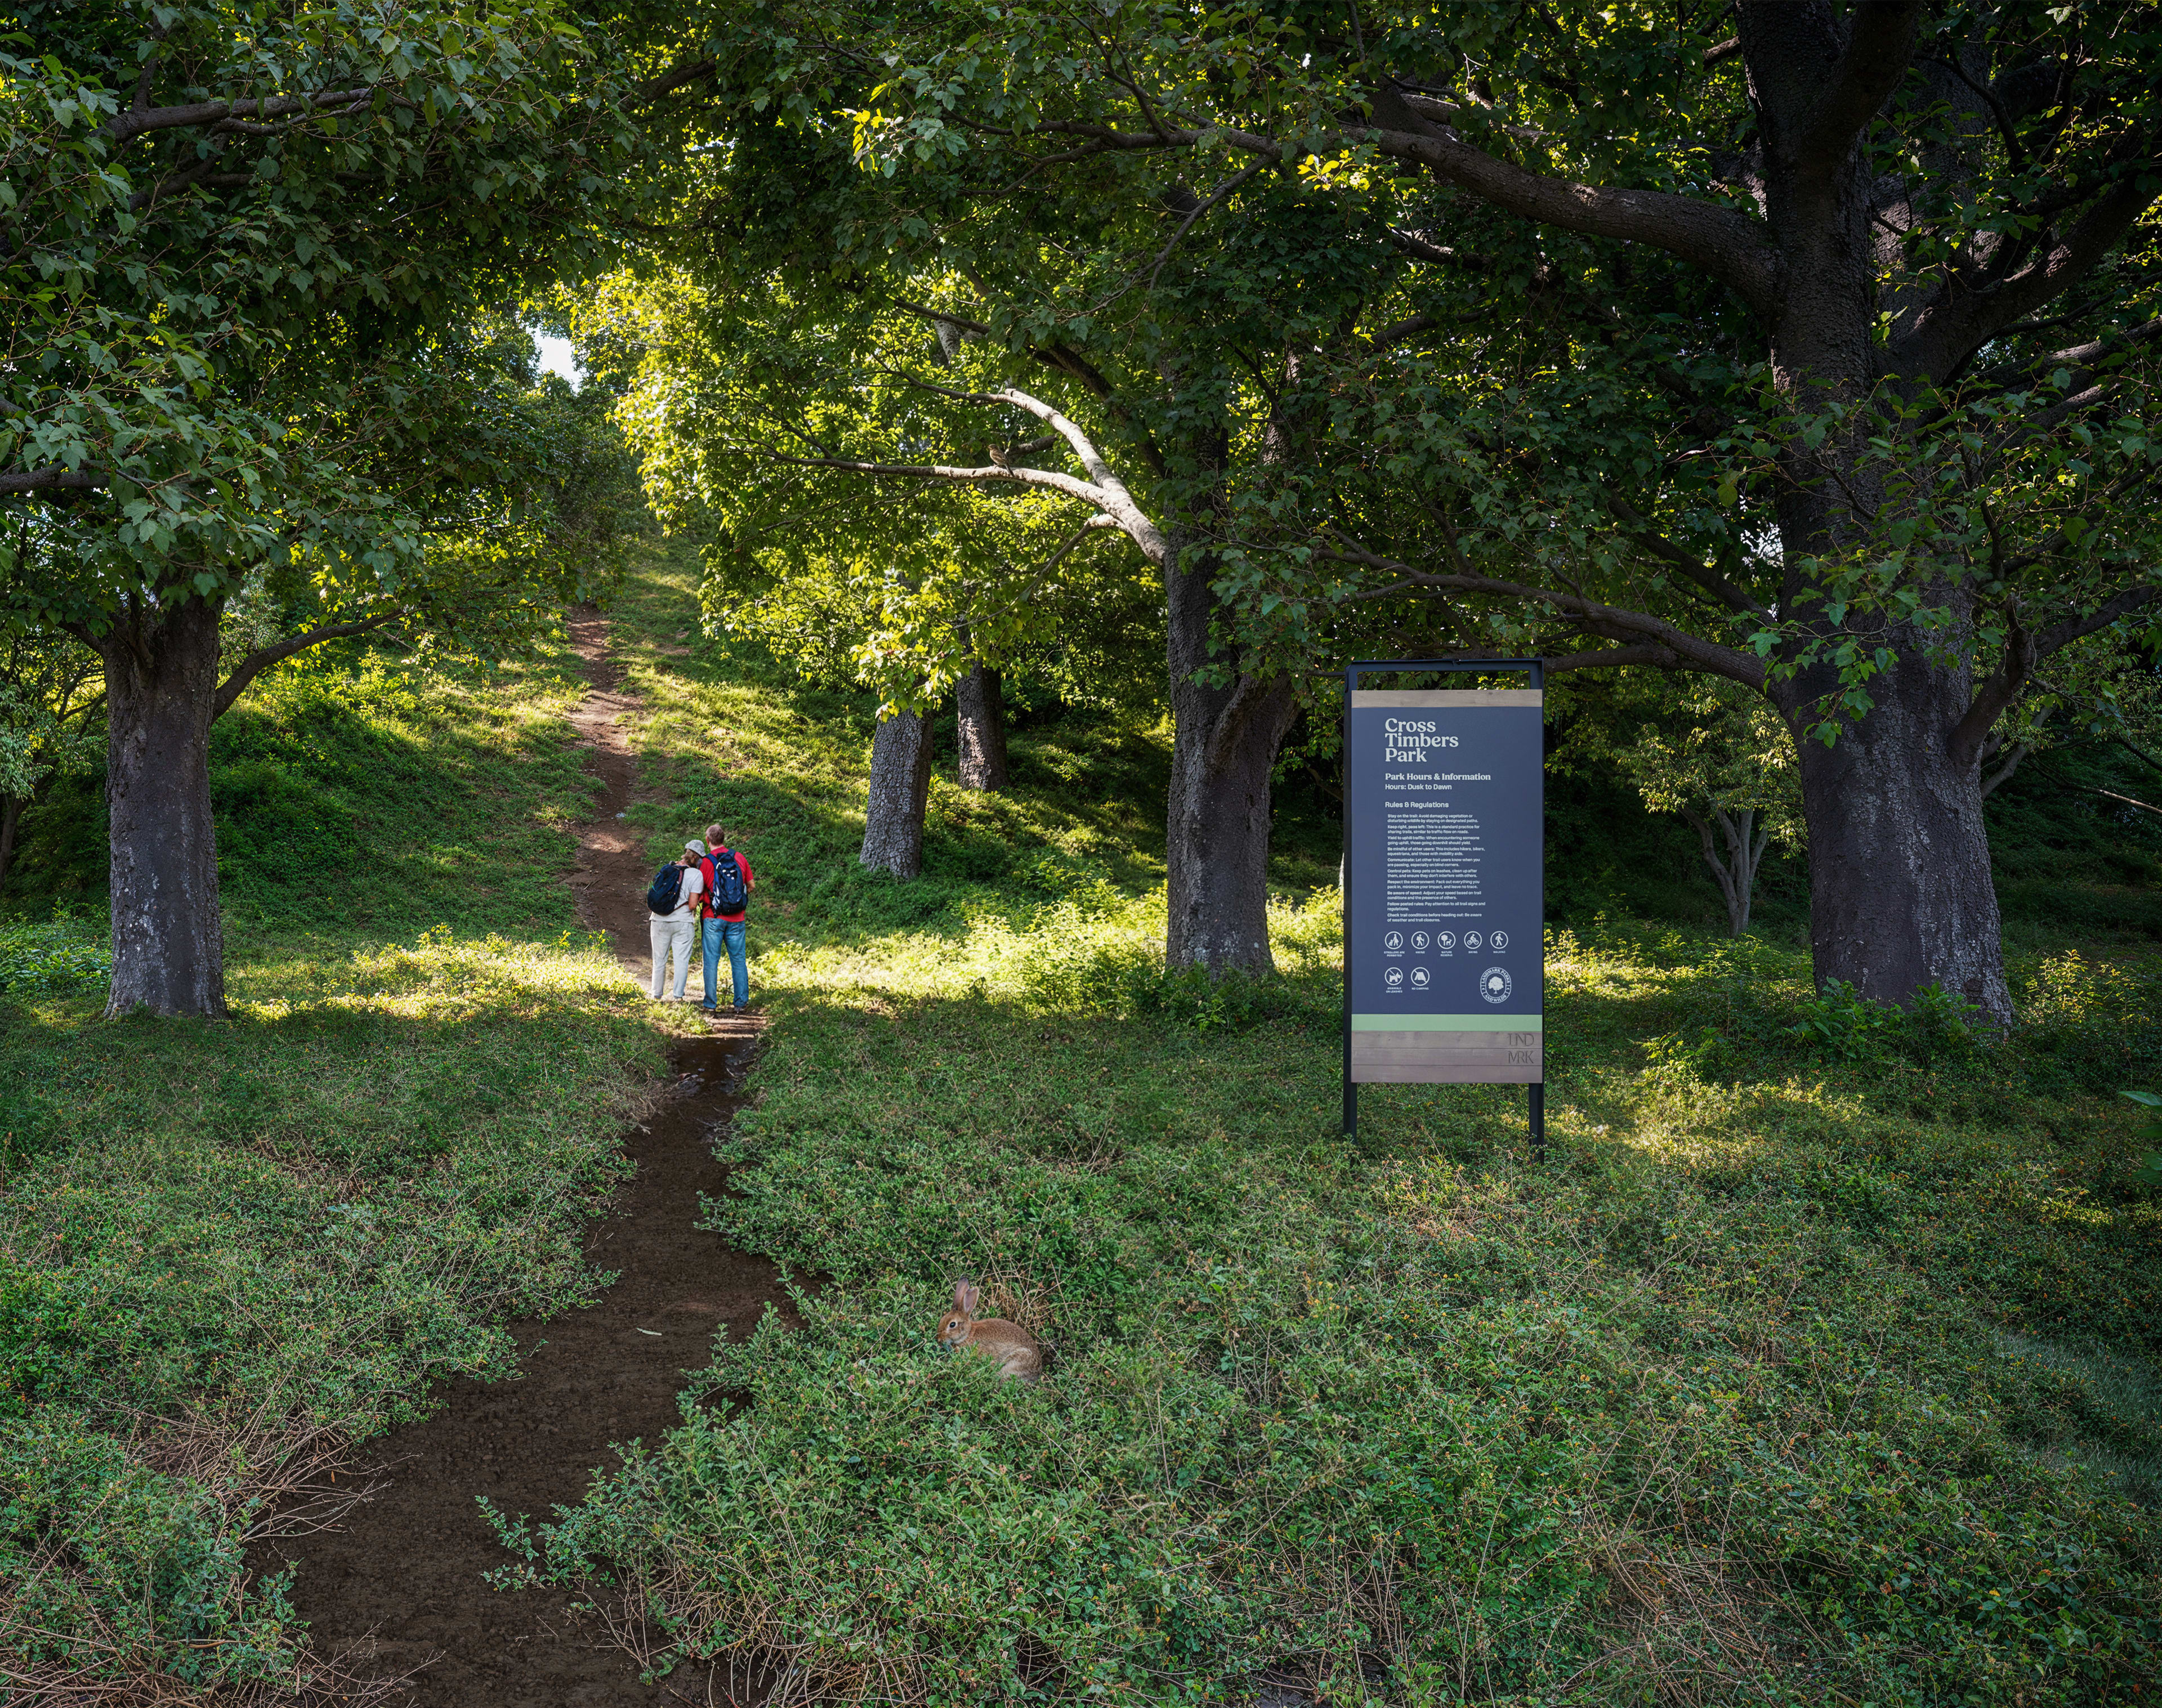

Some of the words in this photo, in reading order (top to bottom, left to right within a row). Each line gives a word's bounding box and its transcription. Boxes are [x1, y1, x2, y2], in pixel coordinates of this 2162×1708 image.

[1385, 718, 1436, 732] Cross
[1385, 732, 1459, 748] Timbers
[1385, 748, 1427, 762] Park
[1481, 968, 1500, 983] LANDMARK
[1501, 970, 1510, 983] PARKS
[1507, 1050, 1534, 1064] MRK
